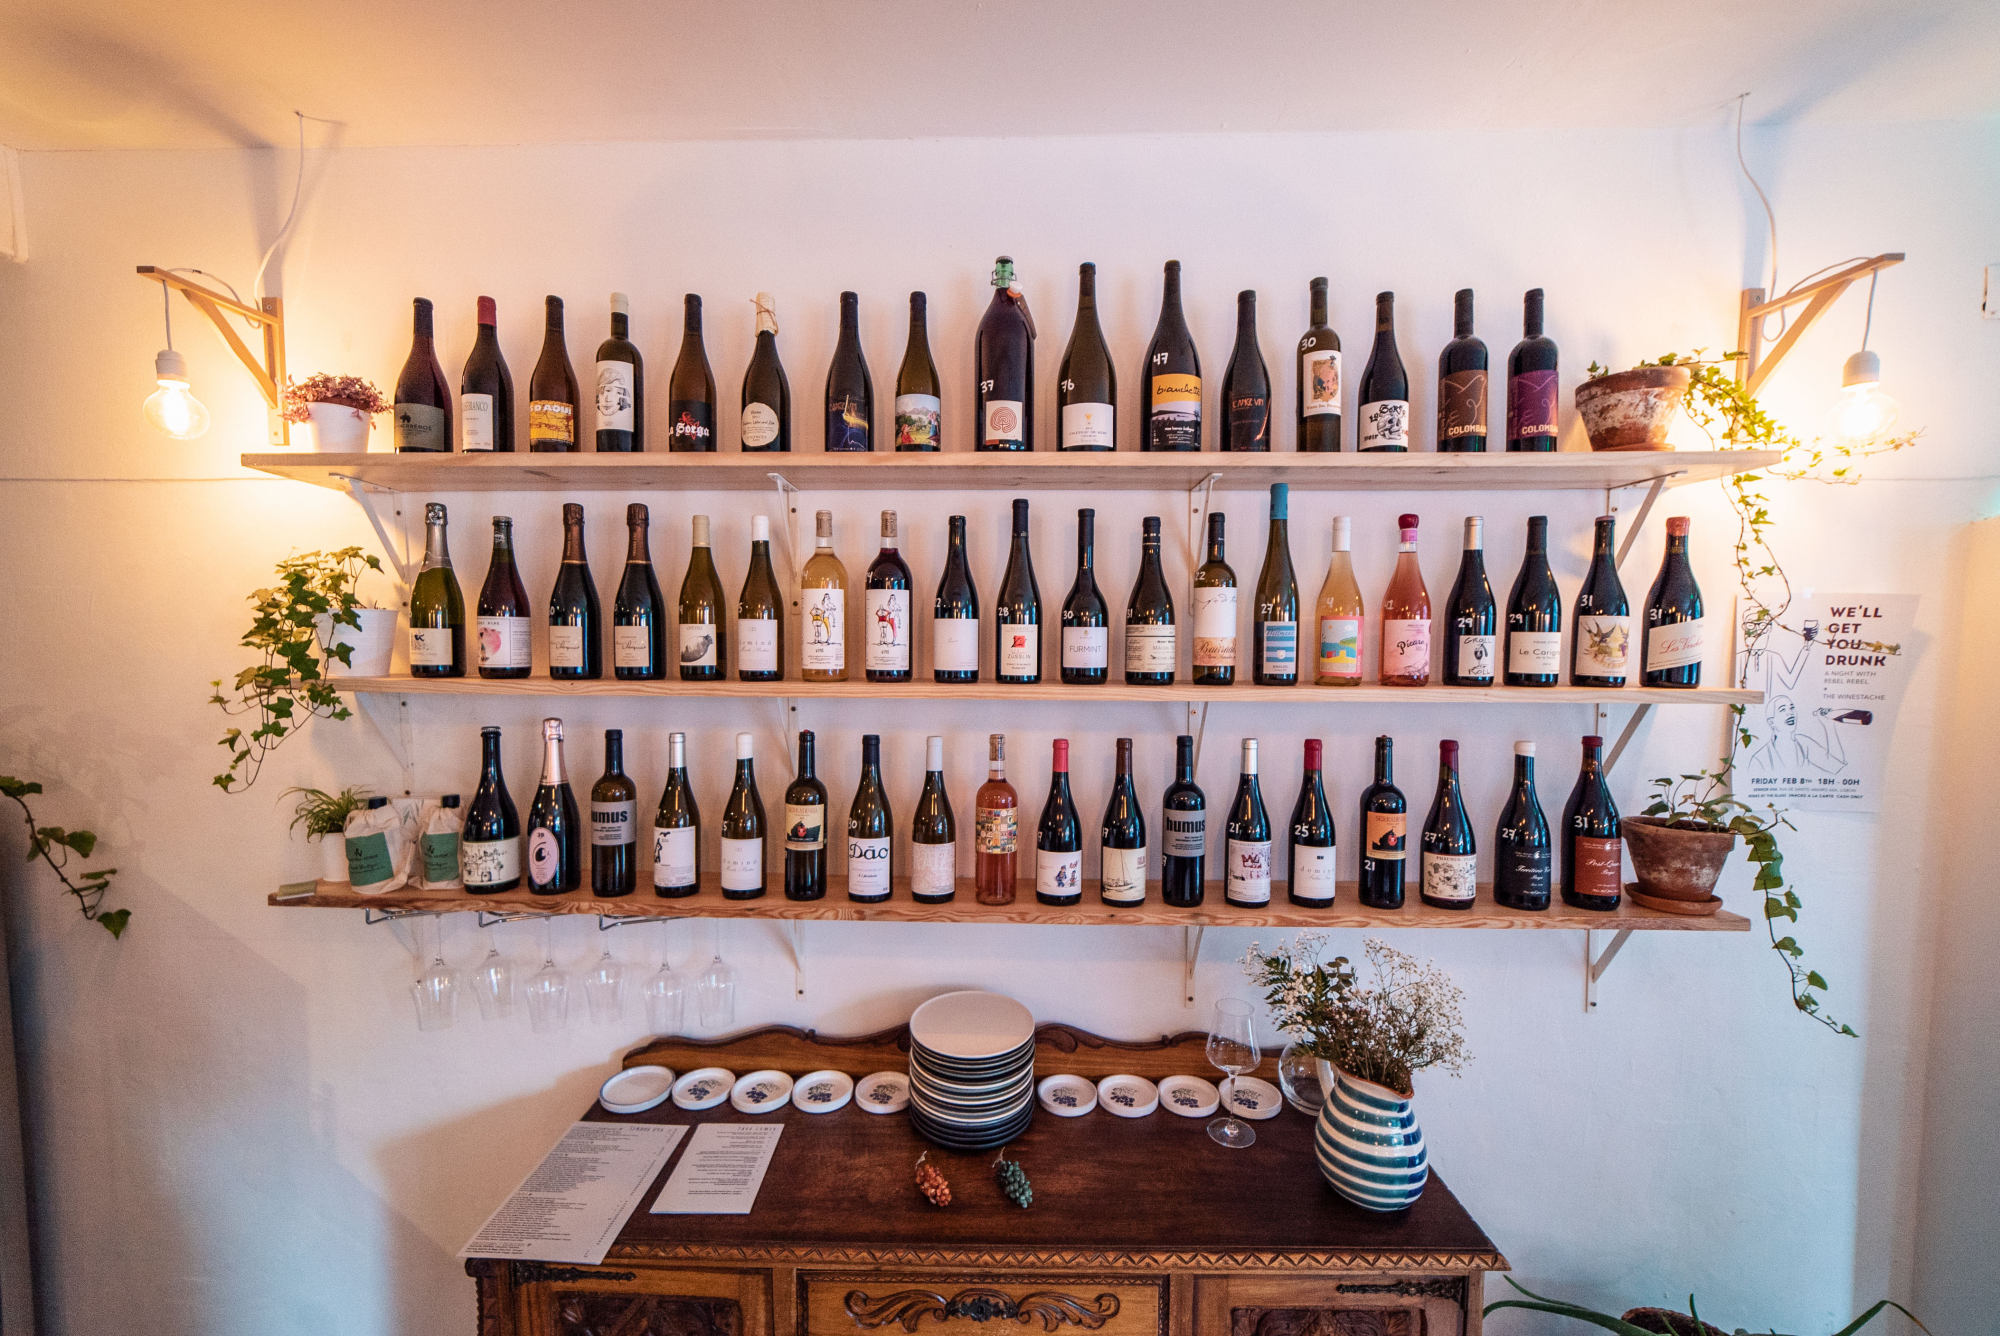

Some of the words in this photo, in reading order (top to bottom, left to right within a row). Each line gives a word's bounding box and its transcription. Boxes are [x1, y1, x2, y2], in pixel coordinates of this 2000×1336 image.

[1301, 337, 1316, 351] 30
[1153, 352, 1169, 365] 47
[980, 379, 994, 393] 37
[1061, 378, 1075, 393] 76
[1580, 595, 1593, 607] 31
[998, 606, 1010, 617] 28
[1261, 603, 1273, 614] 27
[1649, 608, 1662, 621] 31
[1830, 605, 1883, 618] WE'LL
[1062, 610, 1075, 620] 30
[1508, 613, 1524, 624] 29
[1458, 617, 1473, 628] 29
[1827, 623, 1862, 634] GET
[1826, 639, 1862, 650] YOU
[1825, 655, 1887, 667] DRUNK
[1837, 693, 1886, 701] WINESTACHE
[1782, 777, 1797, 785] FEB
[1818, 778, 1835, 786] 18H
[1842, 778, 1860, 786] 00H
[1166, 816, 1205, 833] humus
[1573, 815, 1588, 829] 31
[1294, 824, 1309, 838] 25
[1502, 828, 1516, 840] 27
[1424, 832, 1437, 843] 27
[849, 841, 889, 860] Dão
[1364, 860, 1376, 871] 21
